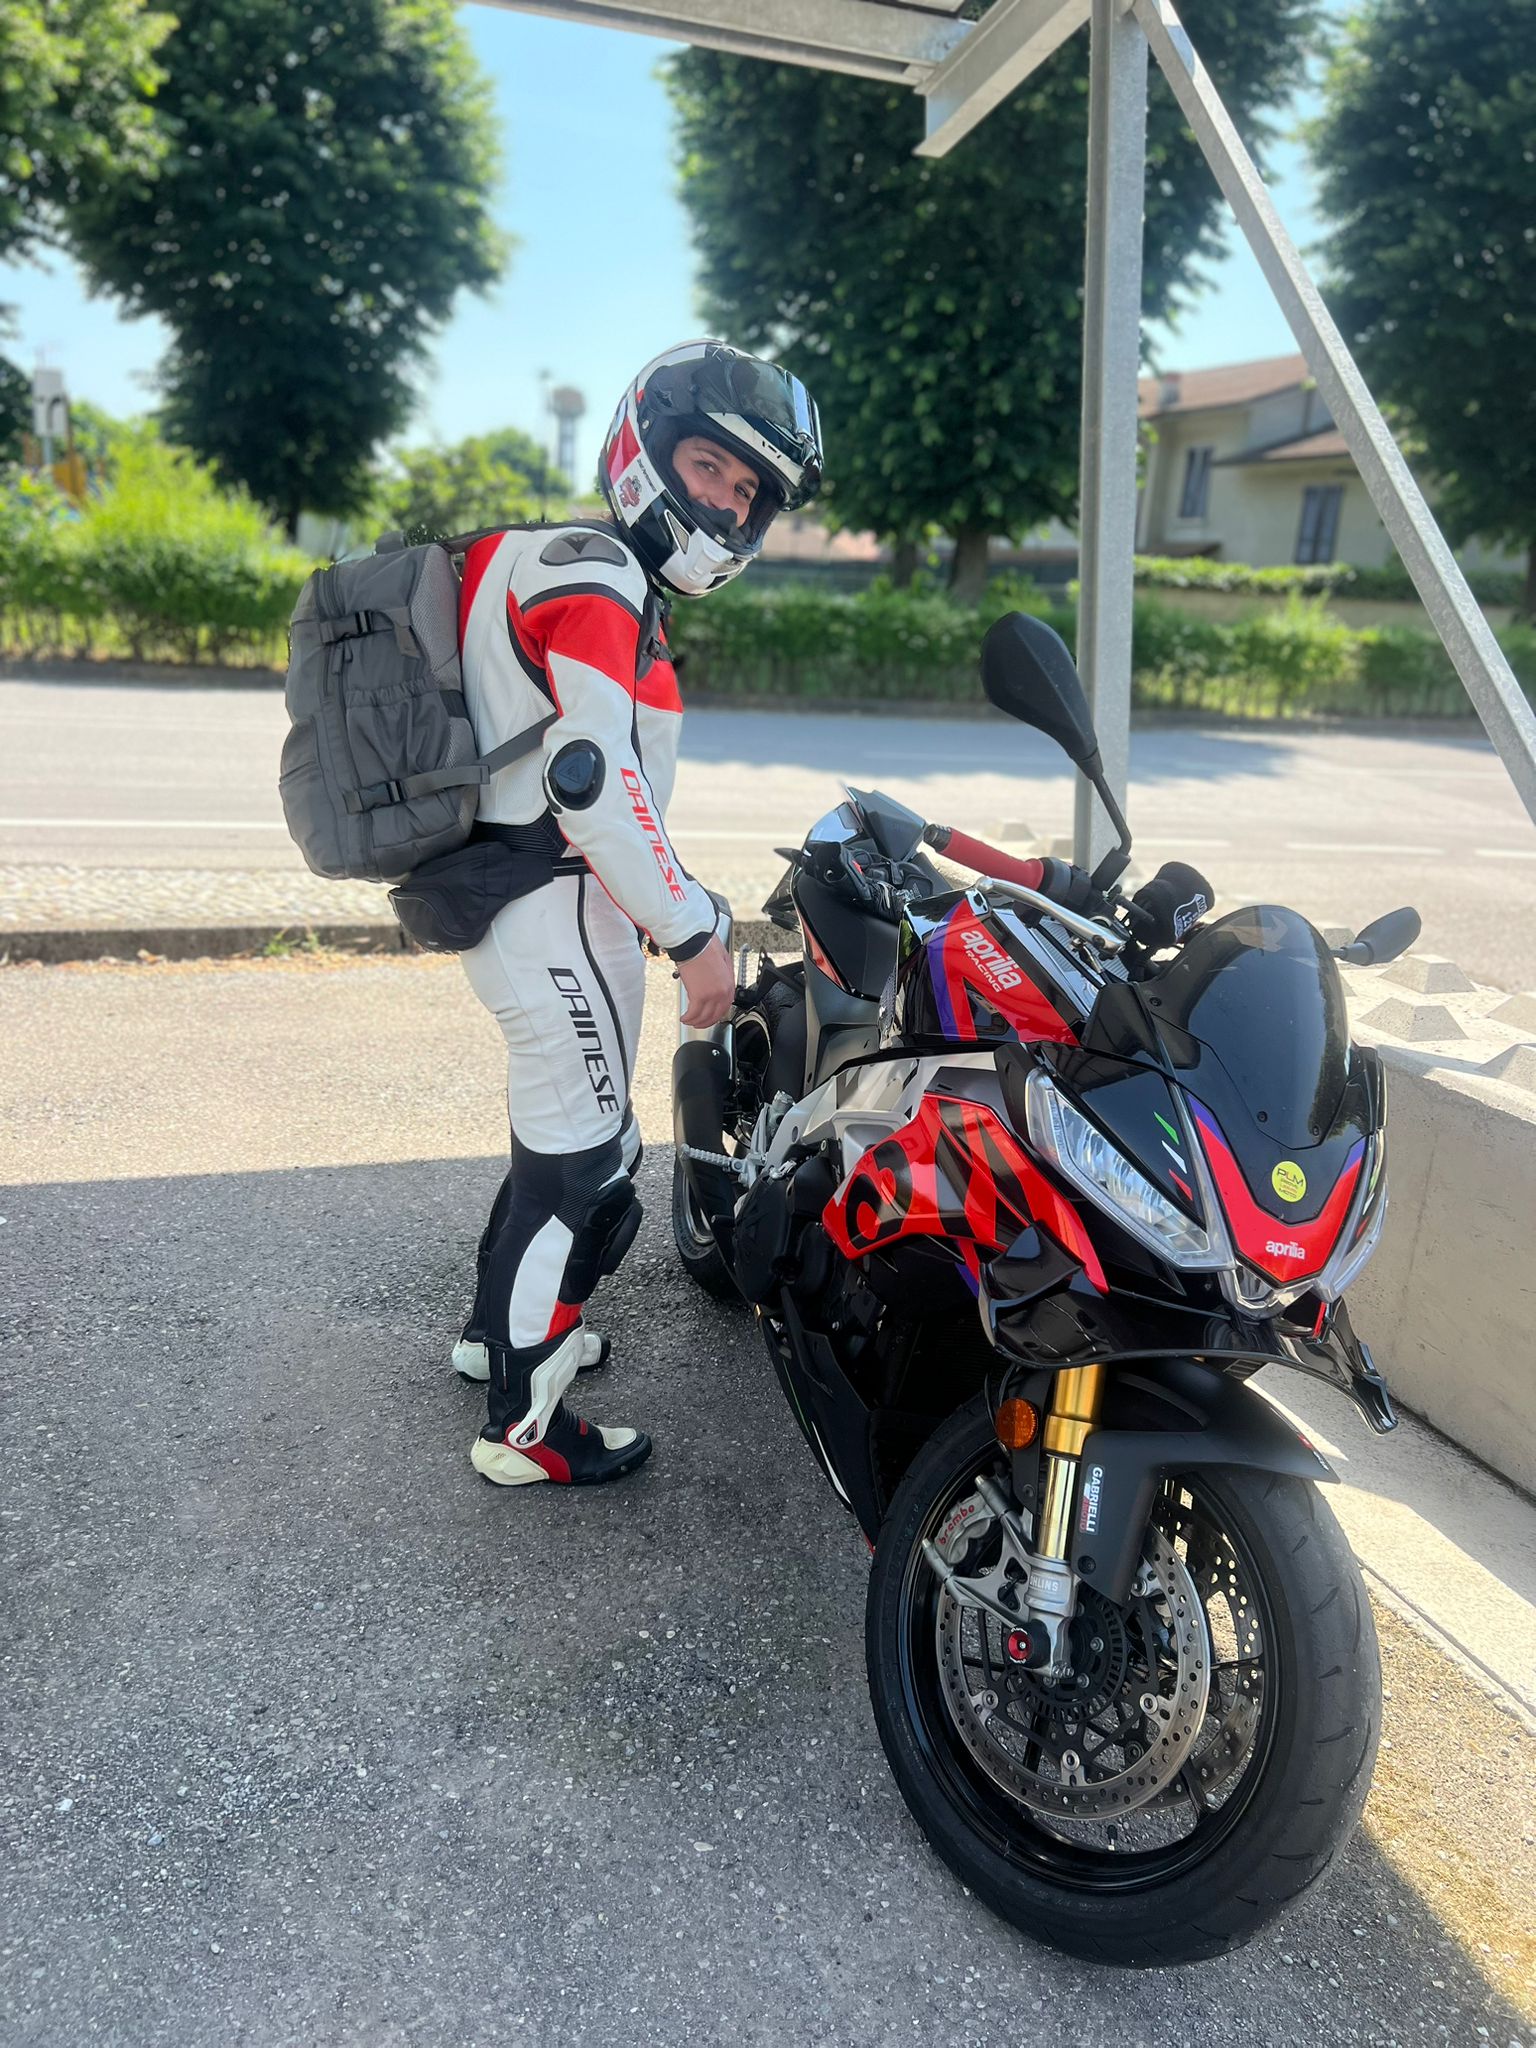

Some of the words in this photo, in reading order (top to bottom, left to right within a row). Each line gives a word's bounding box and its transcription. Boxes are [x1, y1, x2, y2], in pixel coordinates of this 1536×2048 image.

[620, 767, 687, 902] DAINESE
[960, 930, 1022, 990] aprilia
[966, 950, 1001, 992] RACING
[547, 967, 619, 1114] DAINESE
[1265, 1240, 1305, 1260] aprilia
[938, 1504, 975, 1545] brembo
[1086, 1467, 1103, 1532] GABRIELLI
